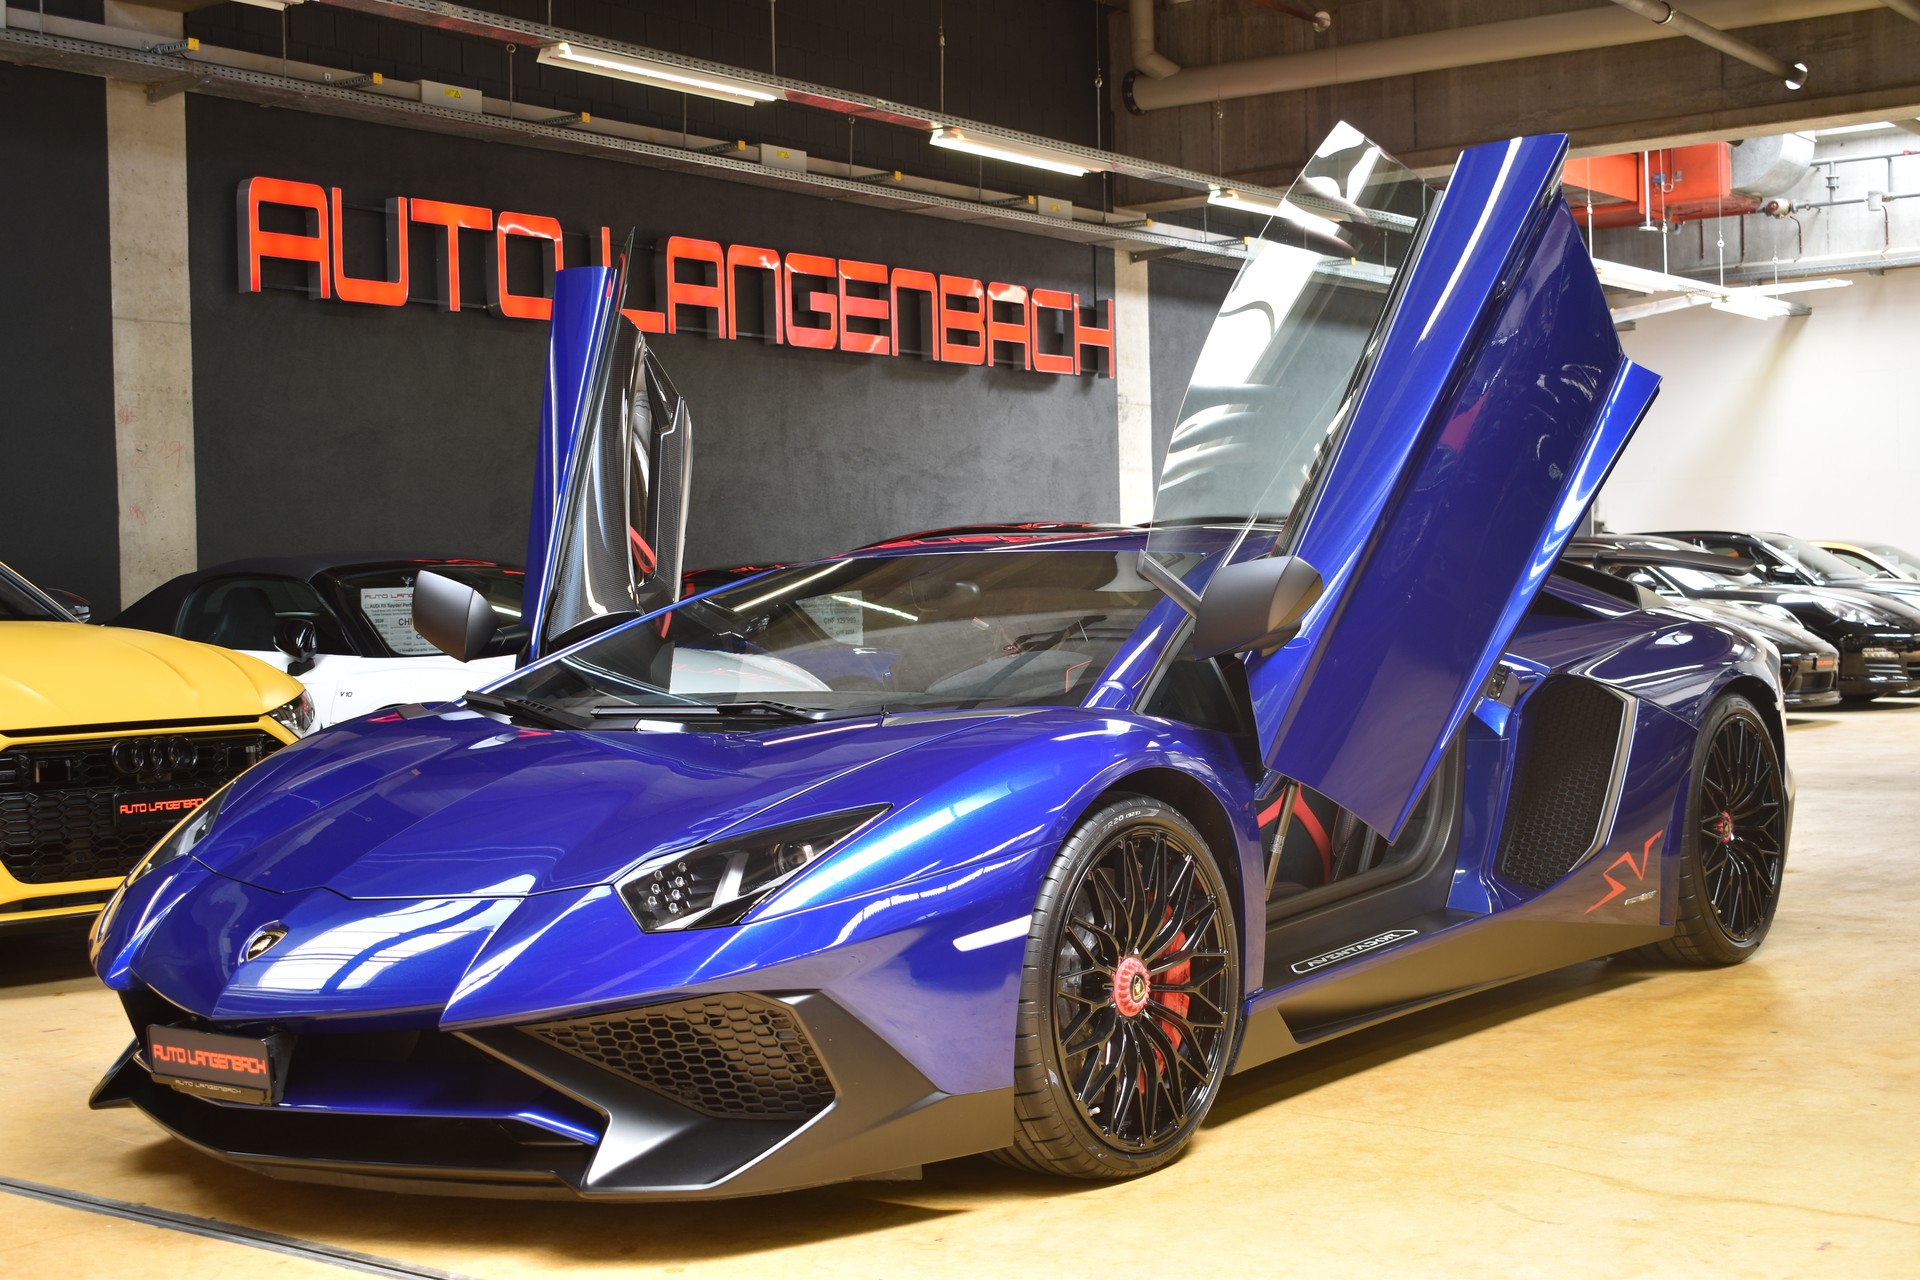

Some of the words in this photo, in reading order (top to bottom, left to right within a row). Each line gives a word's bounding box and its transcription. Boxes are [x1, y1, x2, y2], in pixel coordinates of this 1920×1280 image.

[248, 175, 565, 321] AUTO
[601, 226, 1116, 379] LANGENBACH
[120, 803, 147, 814] AUTO
[149, 798, 204, 811] LANGENBAC
[1307, 932, 1401, 968] AVENTADOR
[152, 1043, 186, 1064] AUTO
[187, 1049, 267, 1075] LANGENBACH
[175, 1079, 194, 1087] AUTO
[195, 1082, 242, 1094] LANGENBACH
